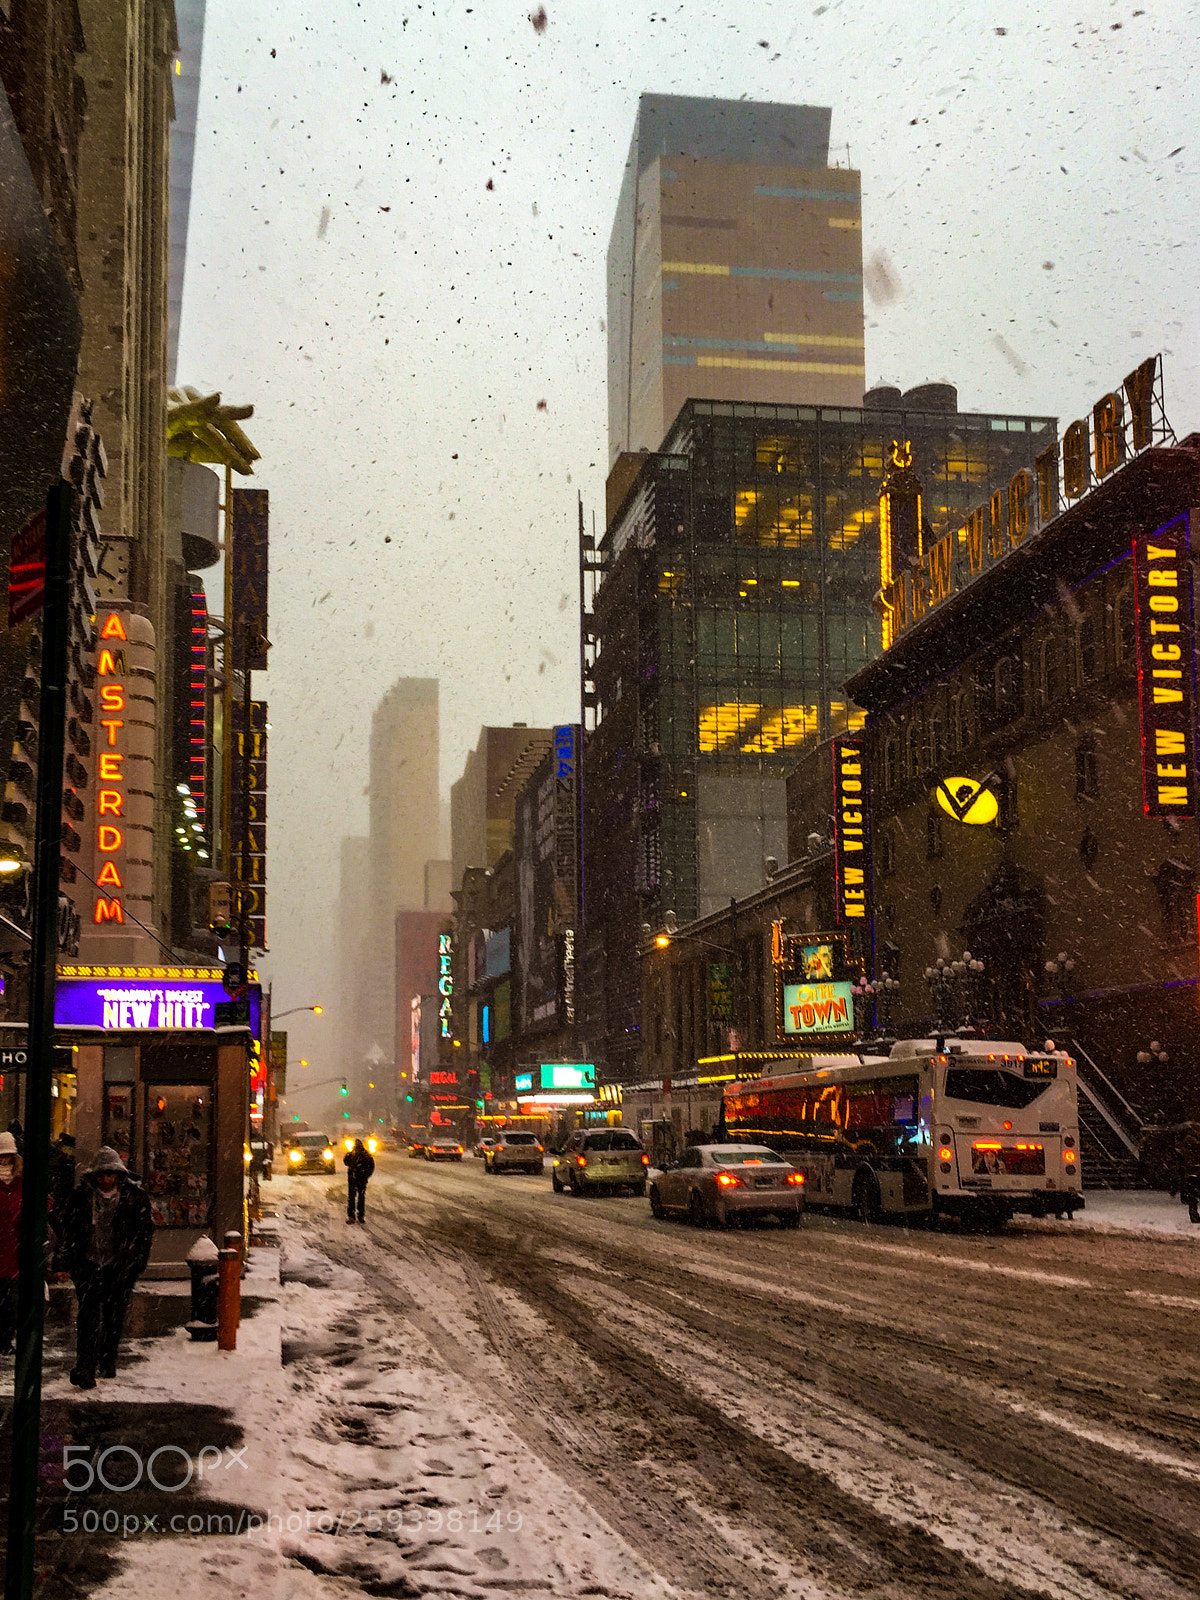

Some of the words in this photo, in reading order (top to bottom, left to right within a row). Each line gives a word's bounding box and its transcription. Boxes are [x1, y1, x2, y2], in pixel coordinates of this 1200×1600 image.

[892, 531, 953, 637] NEW
[966, 355, 1157, 576] VICTORY
[1146, 543, 1185, 705] VICTORY
[94, 612, 129, 925] AMSTERDAM
[554, 725, 575, 759] NEW
[1154, 729, 1189, 807] NEW
[840, 745, 864, 853] VICTORY
[844, 866, 866, 918] NEW
[103, 1001, 152, 1028] NEW
[437, 933, 454, 1039] REGAL
[789, 996, 849, 1030] TOWN
